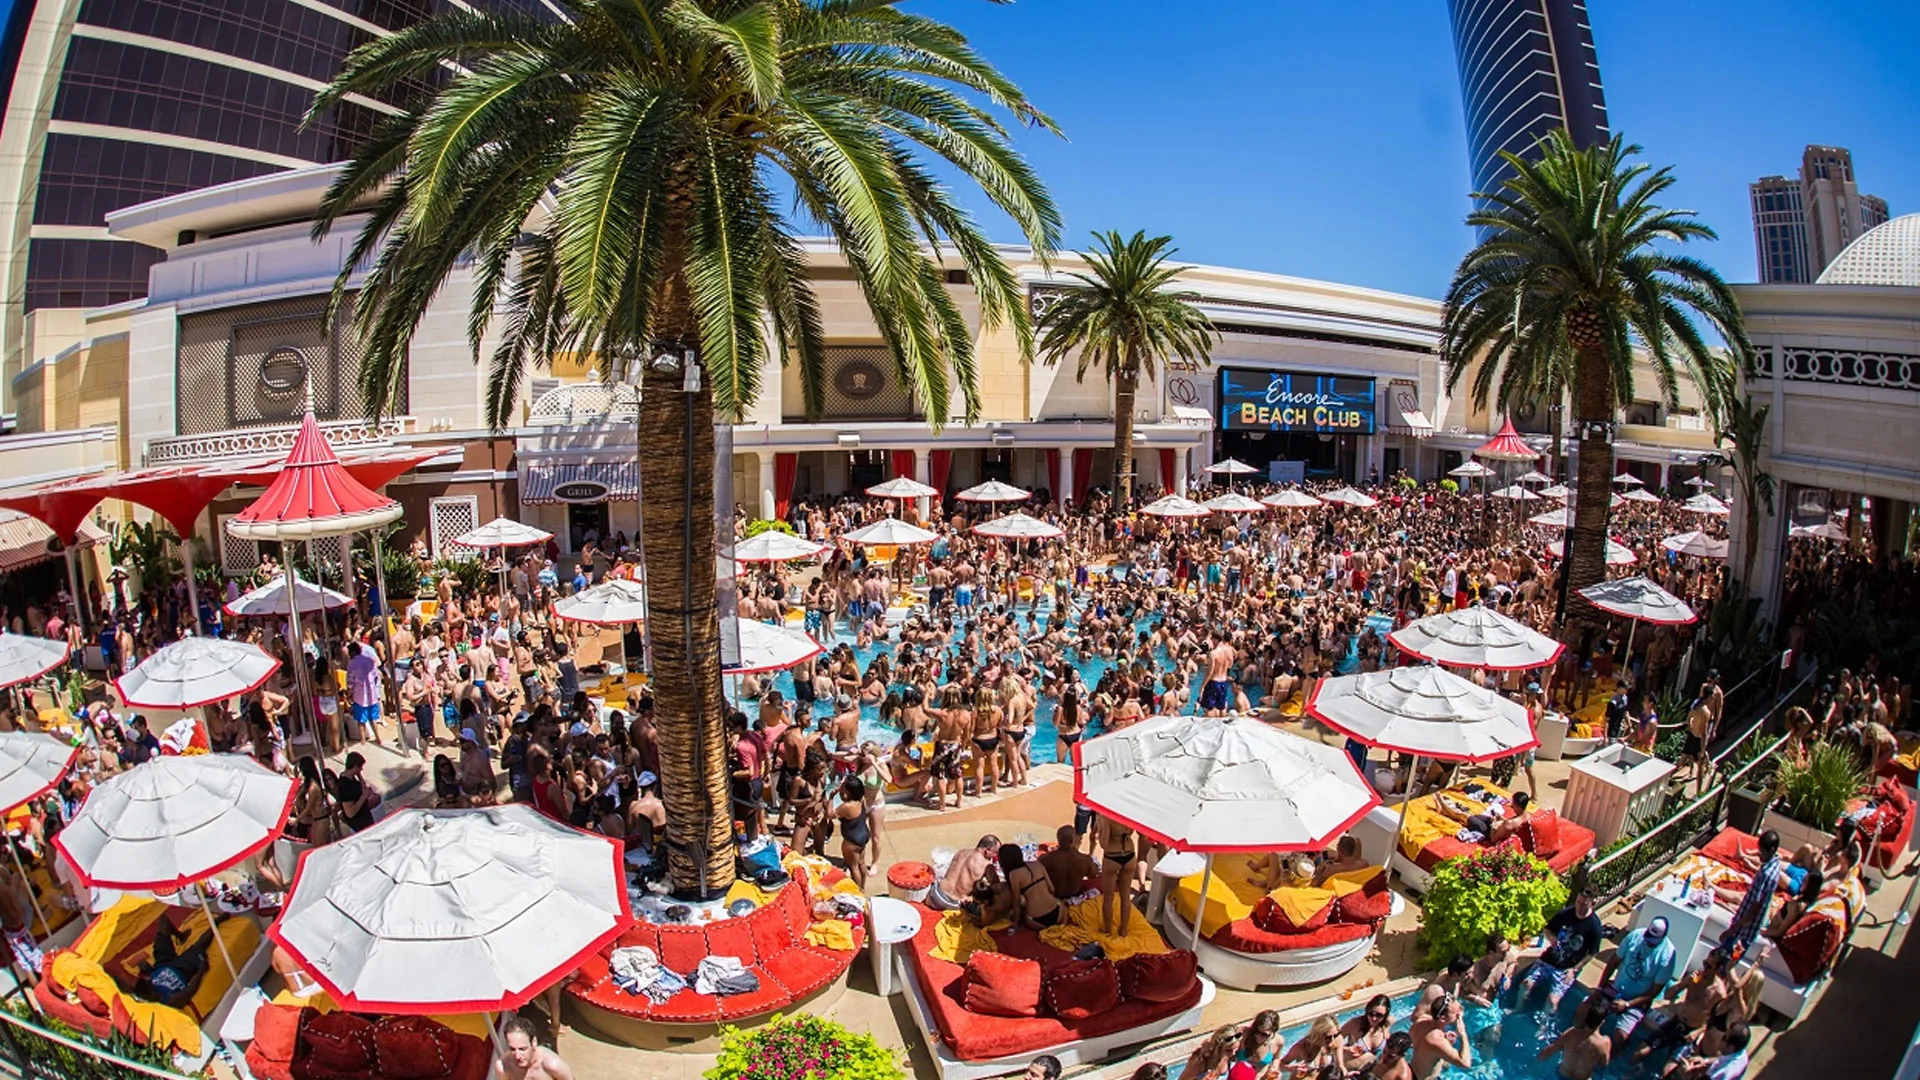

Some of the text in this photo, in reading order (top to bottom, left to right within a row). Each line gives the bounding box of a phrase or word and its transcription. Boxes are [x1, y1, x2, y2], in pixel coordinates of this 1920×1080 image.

[1265, 378, 1344, 406] Encore
[1241, 402, 1361, 428] BEACH CLUB
[566, 488, 594, 496] GRILL
